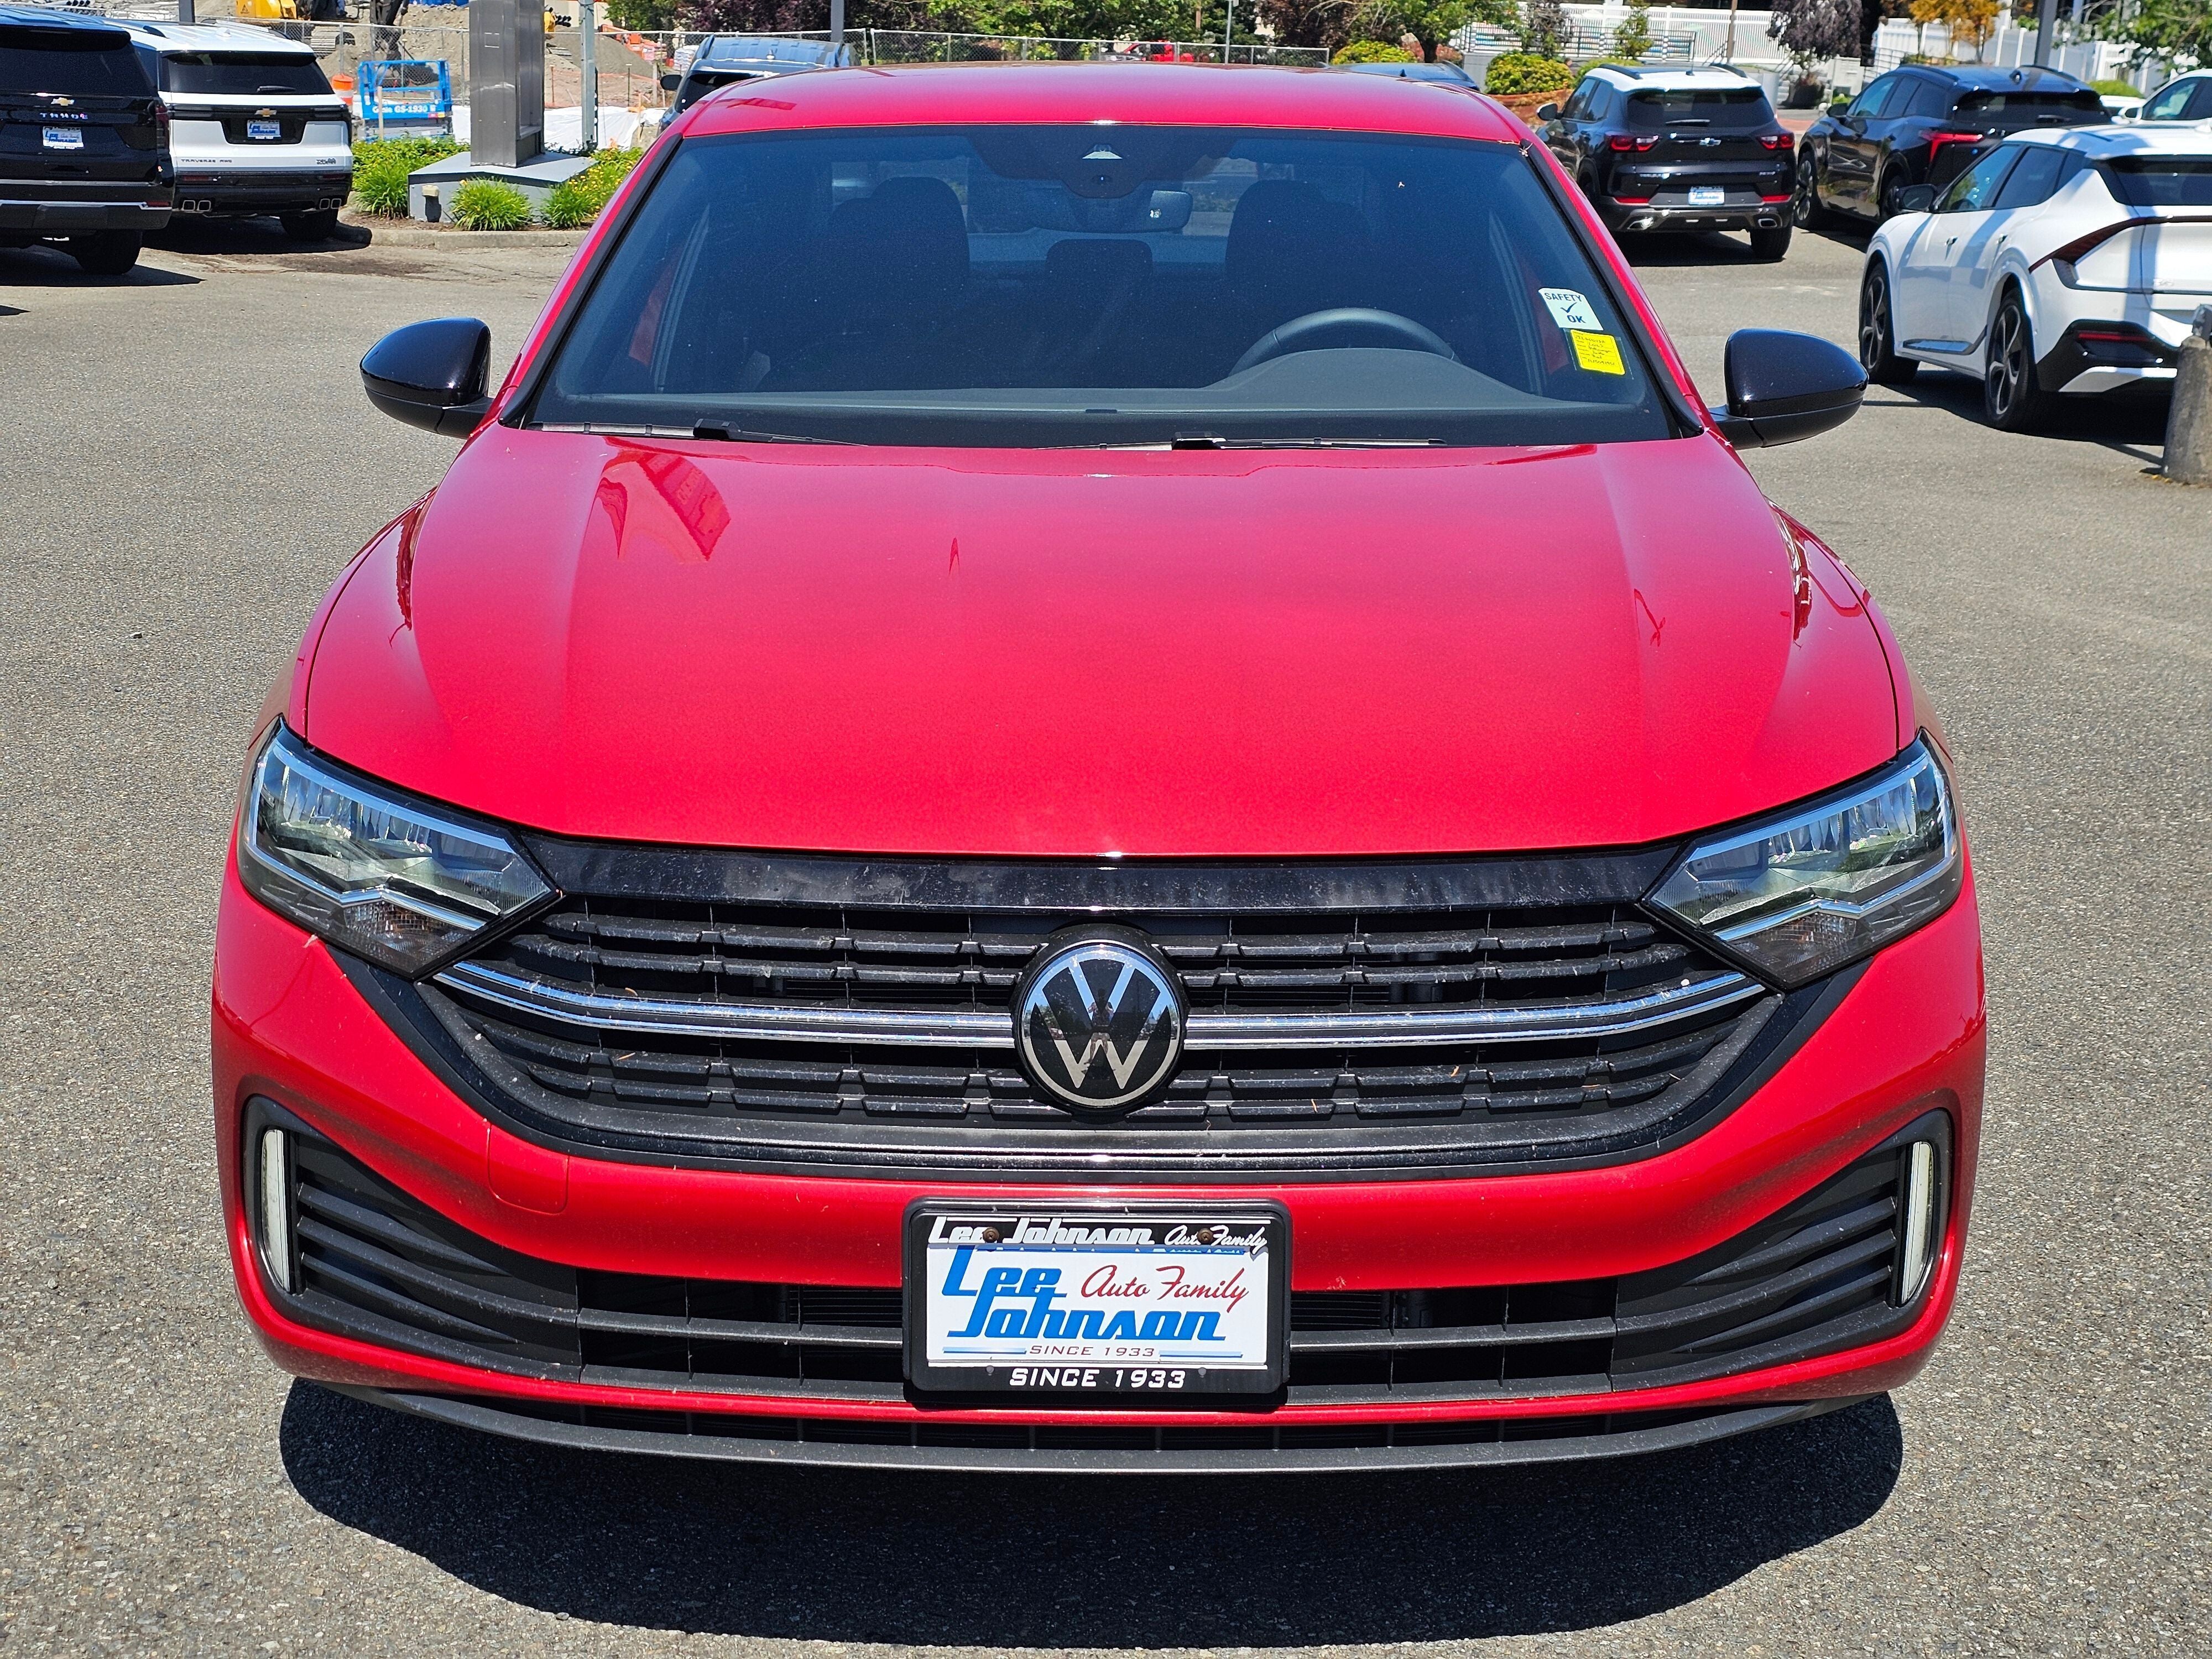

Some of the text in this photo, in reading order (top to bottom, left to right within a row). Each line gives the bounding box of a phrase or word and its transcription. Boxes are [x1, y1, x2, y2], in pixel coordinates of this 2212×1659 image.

[394, 105, 428, 113] GS-1930
[1544, 293, 1582, 302] SAFETY
[1567, 315, 1587, 324] OK
[1003, 1218, 1155, 1244] Johnson
[1165, 1224, 1208, 1245] Aut
[1210, 1224, 1267, 1254] Family
[941, 1245, 1067, 1297] Lee
[1080, 1265, 1249, 1314] Auto Family
[946, 1287, 1227, 1341] Johnson
[1029, 1345, 1155, 1358] SINCE 1933
[1009, 1367, 1186, 1389] SINCE 1933
